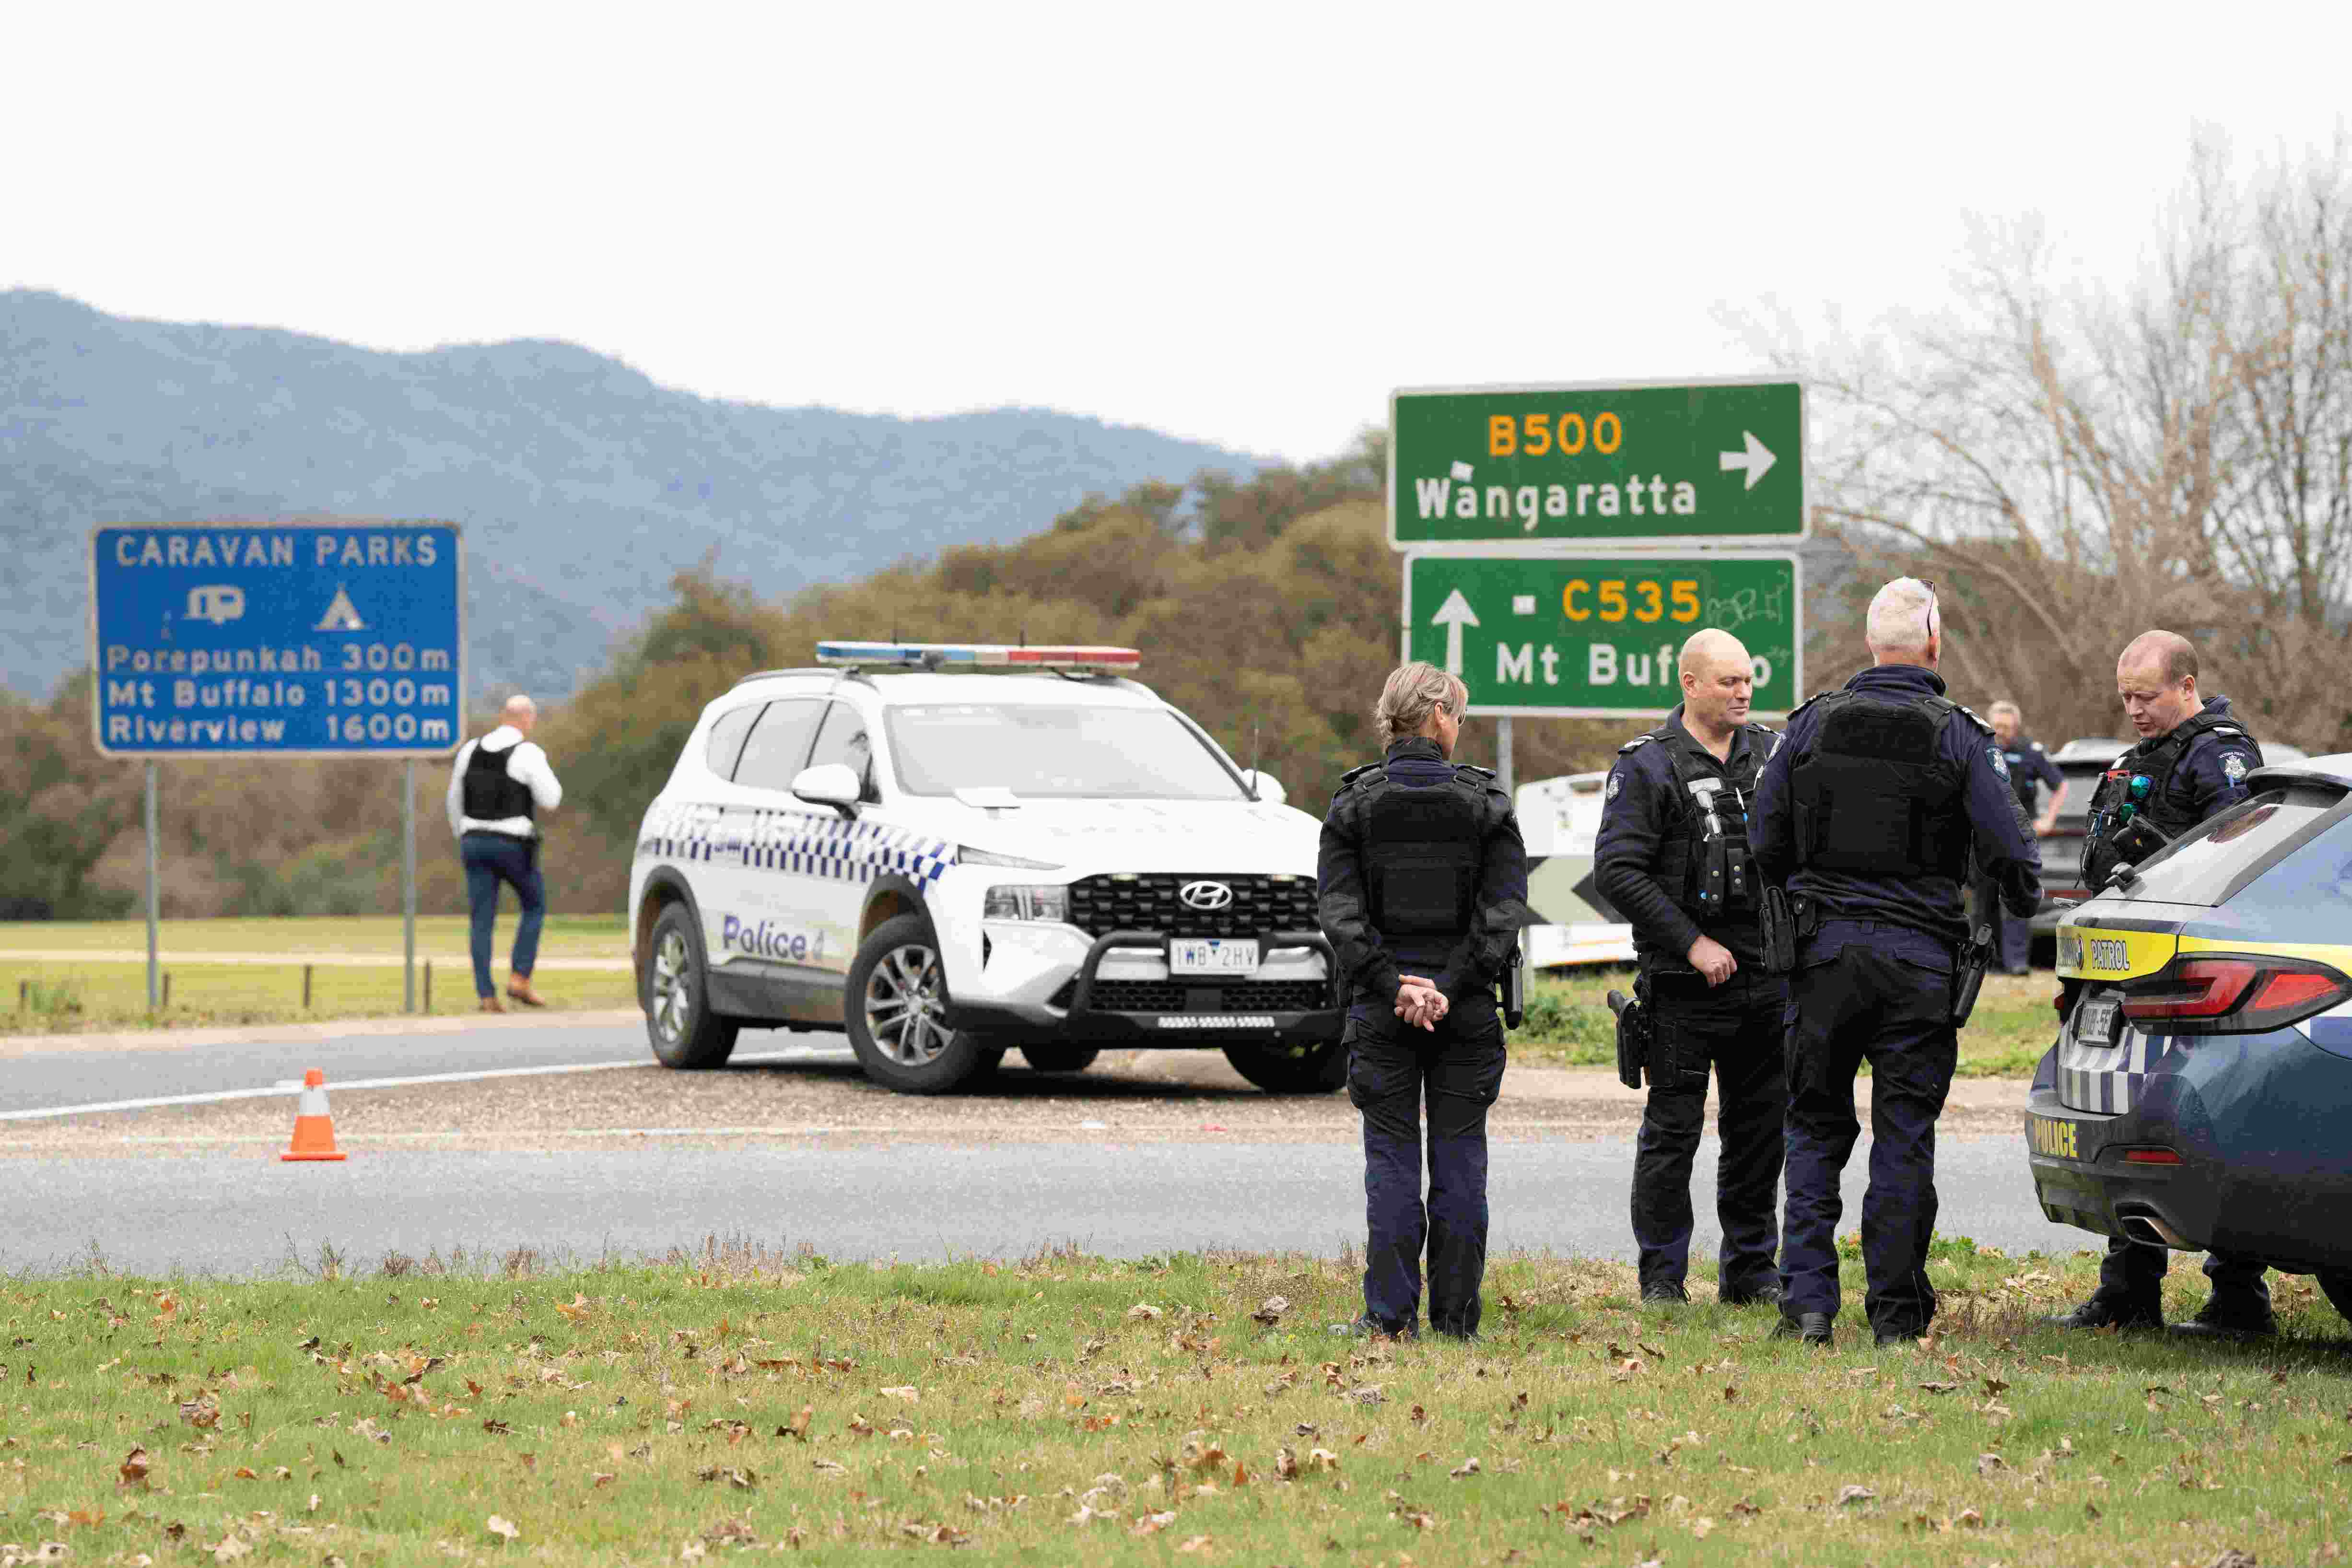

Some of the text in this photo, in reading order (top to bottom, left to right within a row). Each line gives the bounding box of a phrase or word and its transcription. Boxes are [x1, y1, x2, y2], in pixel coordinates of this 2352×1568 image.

[1488, 411, 1622, 456] B500
[1416, 475, 1696, 530] Wangaratta
[116, 534, 437, 567] CARAVAN PARKS
[1562, 579, 1700, 623] C535
[106, 643, 450, 676] Porepunkah 300m
[1496, 642, 1772, 689] Mt Bufo
[107, 679, 450, 708] Mt Buffalo 1300m
[108, 713, 450, 743] Riverview 1600m
[723, 914, 806, 960] Police
[2090, 938, 2130, 971] PATROL
[2034, 1119, 2077, 1158] POLICE
